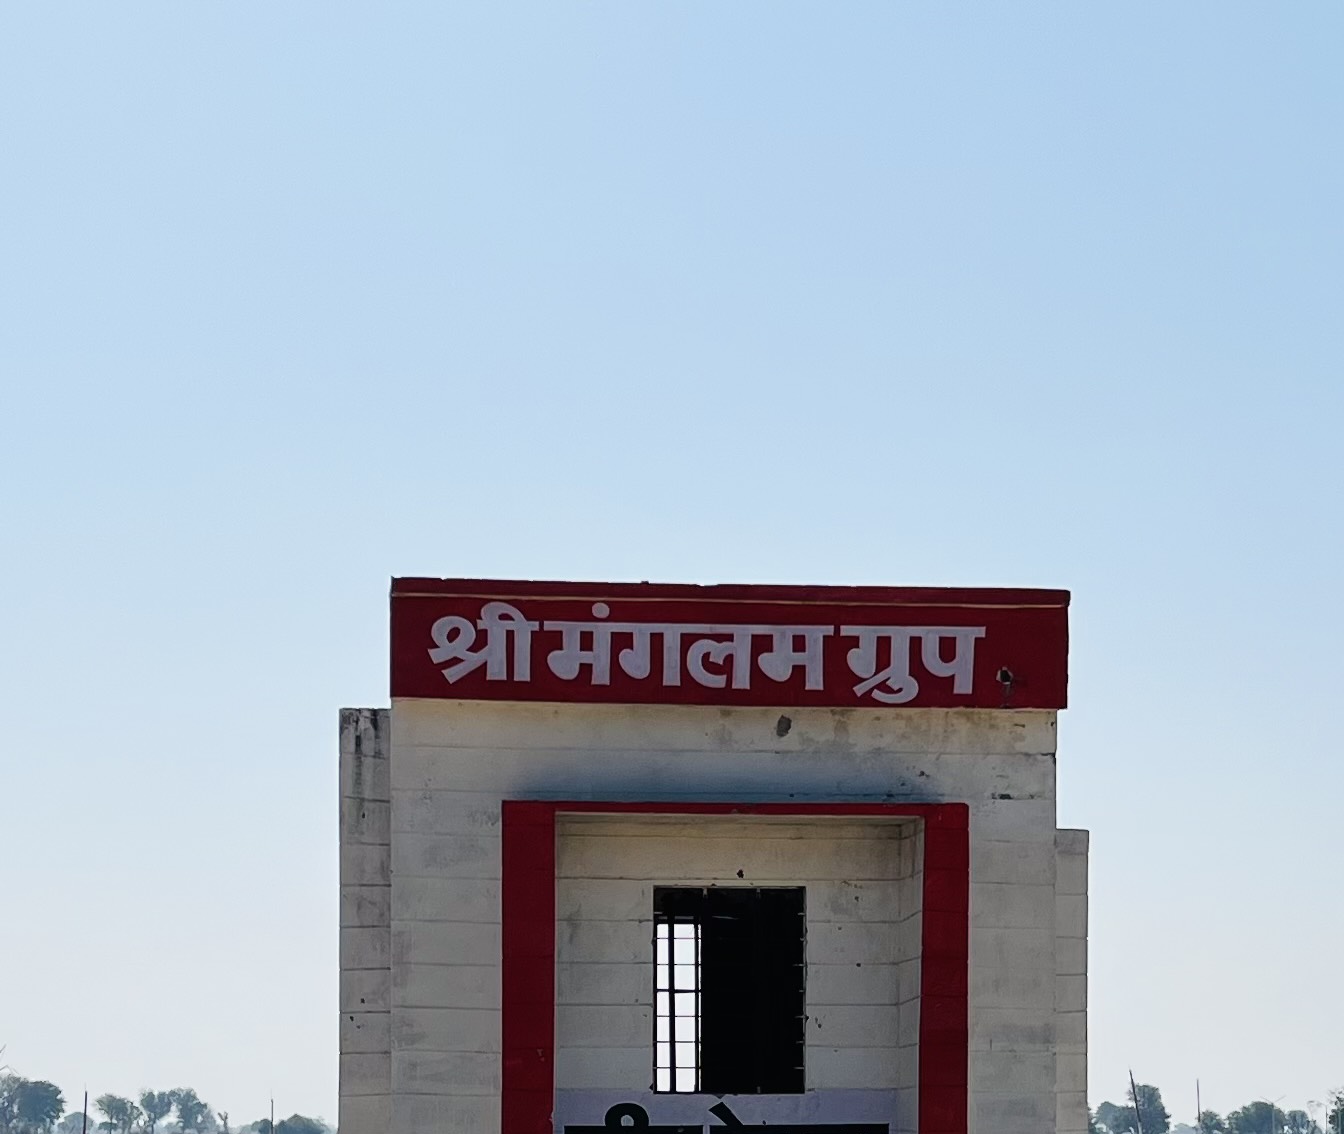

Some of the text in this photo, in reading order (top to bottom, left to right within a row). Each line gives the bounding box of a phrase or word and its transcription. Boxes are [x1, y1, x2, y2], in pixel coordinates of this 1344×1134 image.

[427, 601, 987, 705] श्री मंगलम ग्रुप
